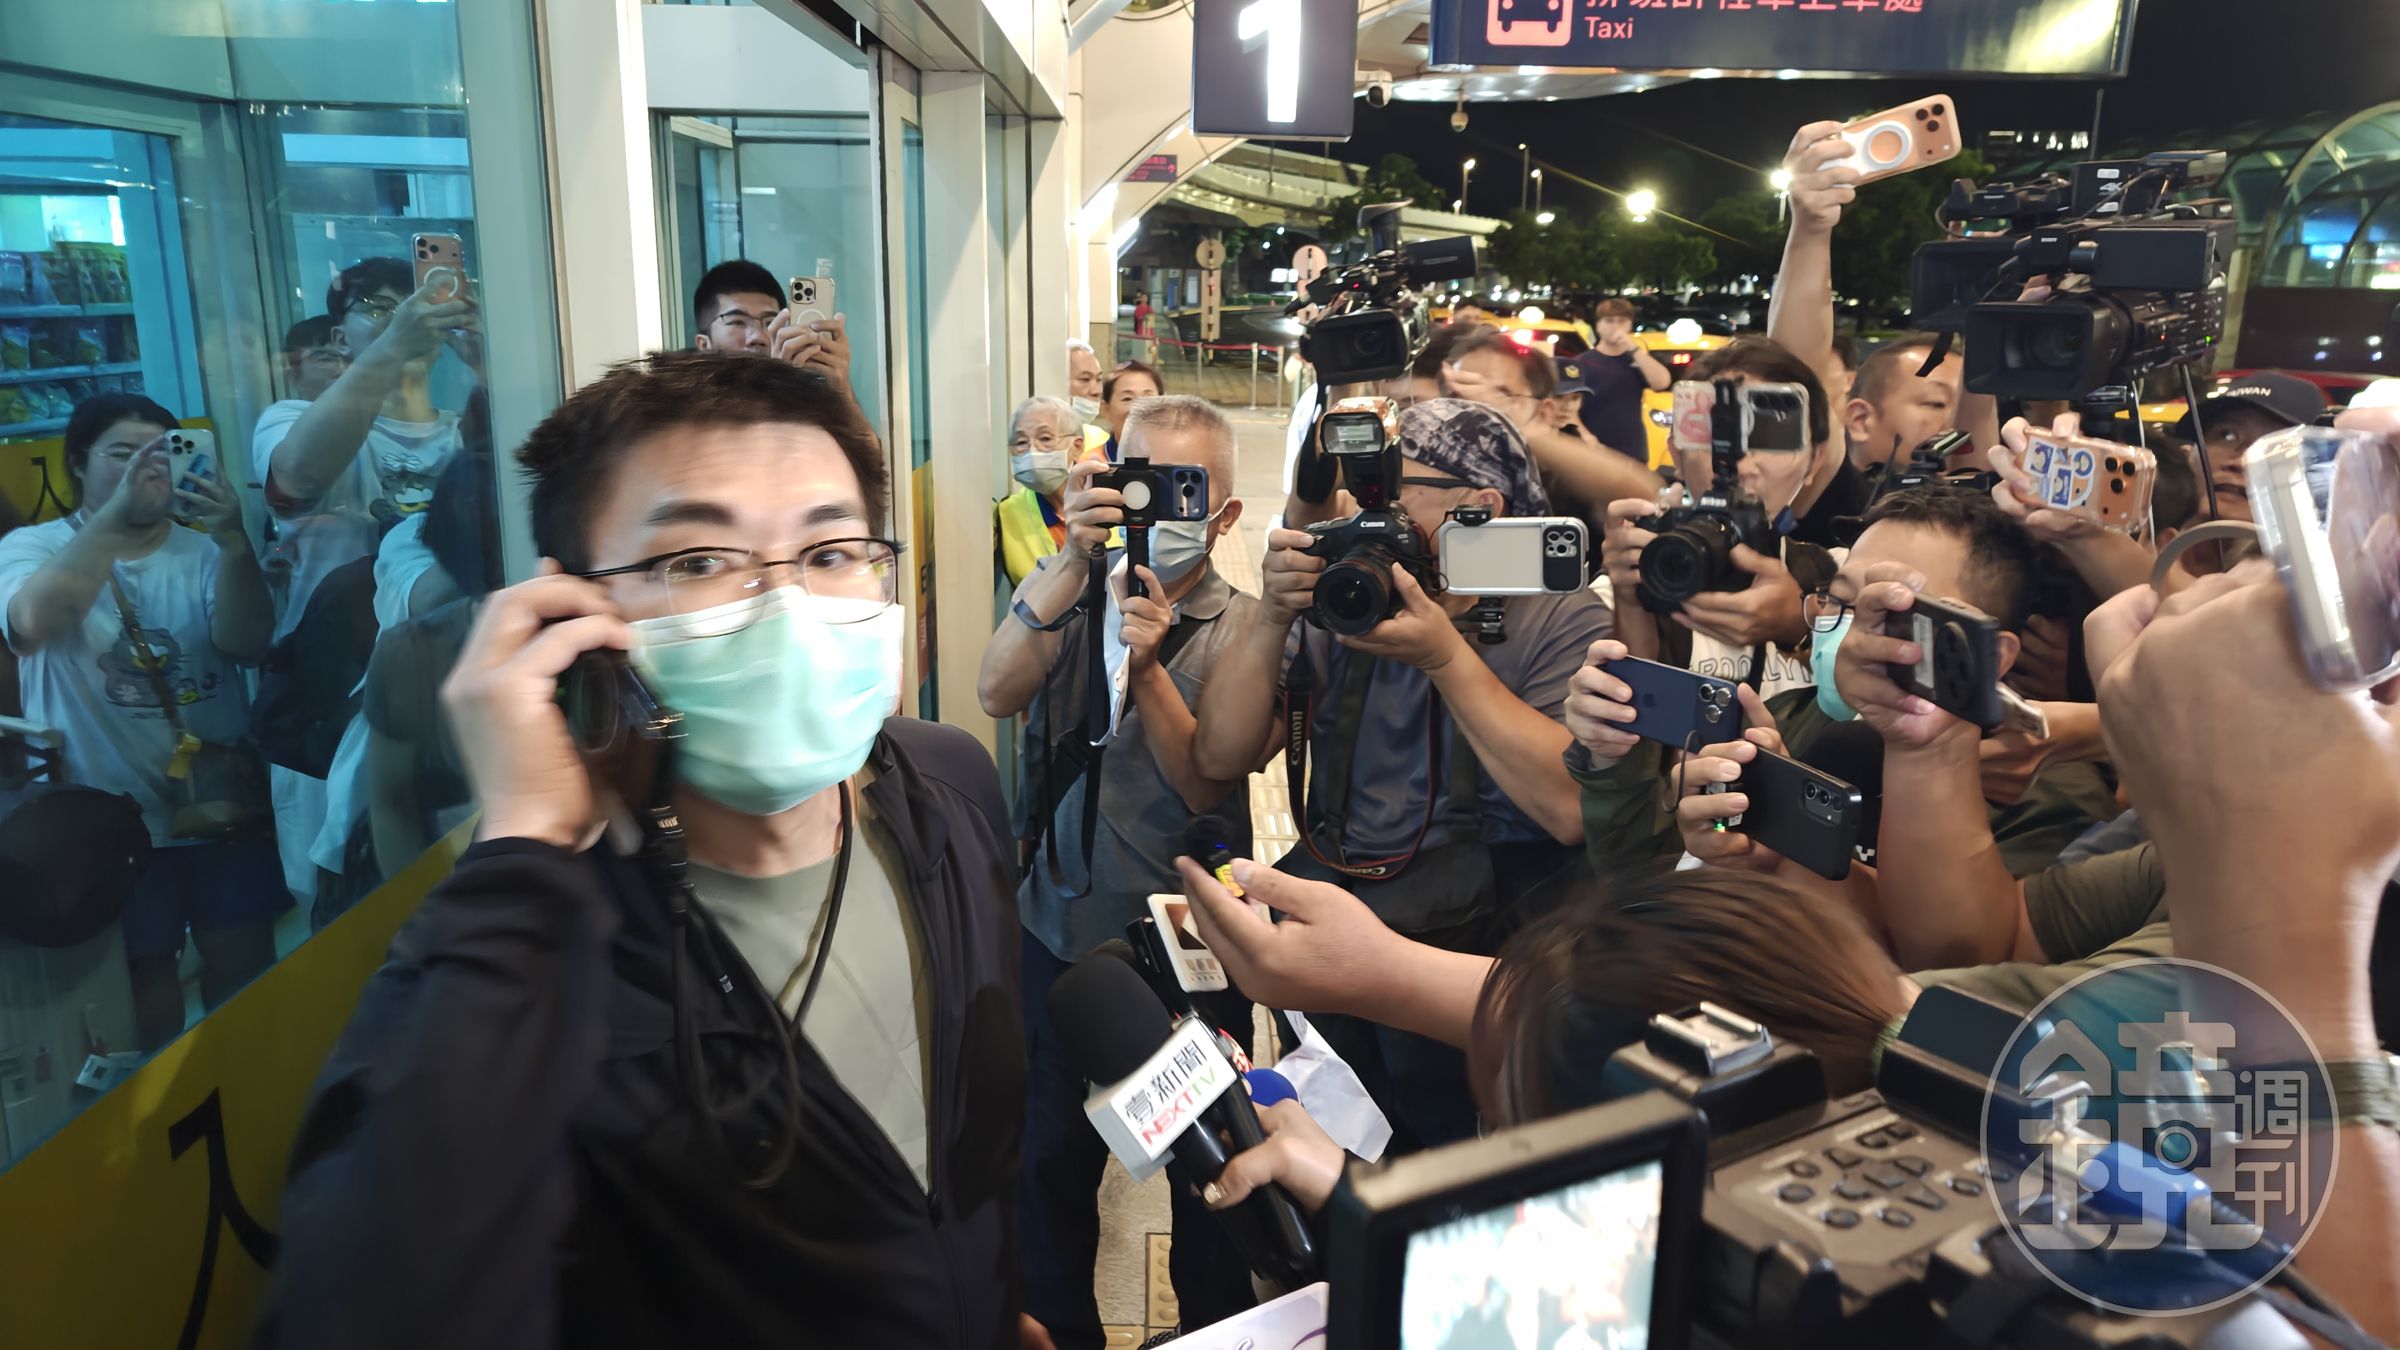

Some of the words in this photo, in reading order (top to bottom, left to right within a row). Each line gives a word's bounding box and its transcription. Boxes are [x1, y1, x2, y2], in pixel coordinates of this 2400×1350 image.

[1584, 16, 1634, 39] Taxi
[1238, 0, 1302, 122] 1
[2225, 386, 2272, 397] AIWAN
[1291, 711, 1304, 766] Canon
[1124, 1039, 1208, 1125] 壹新聞
